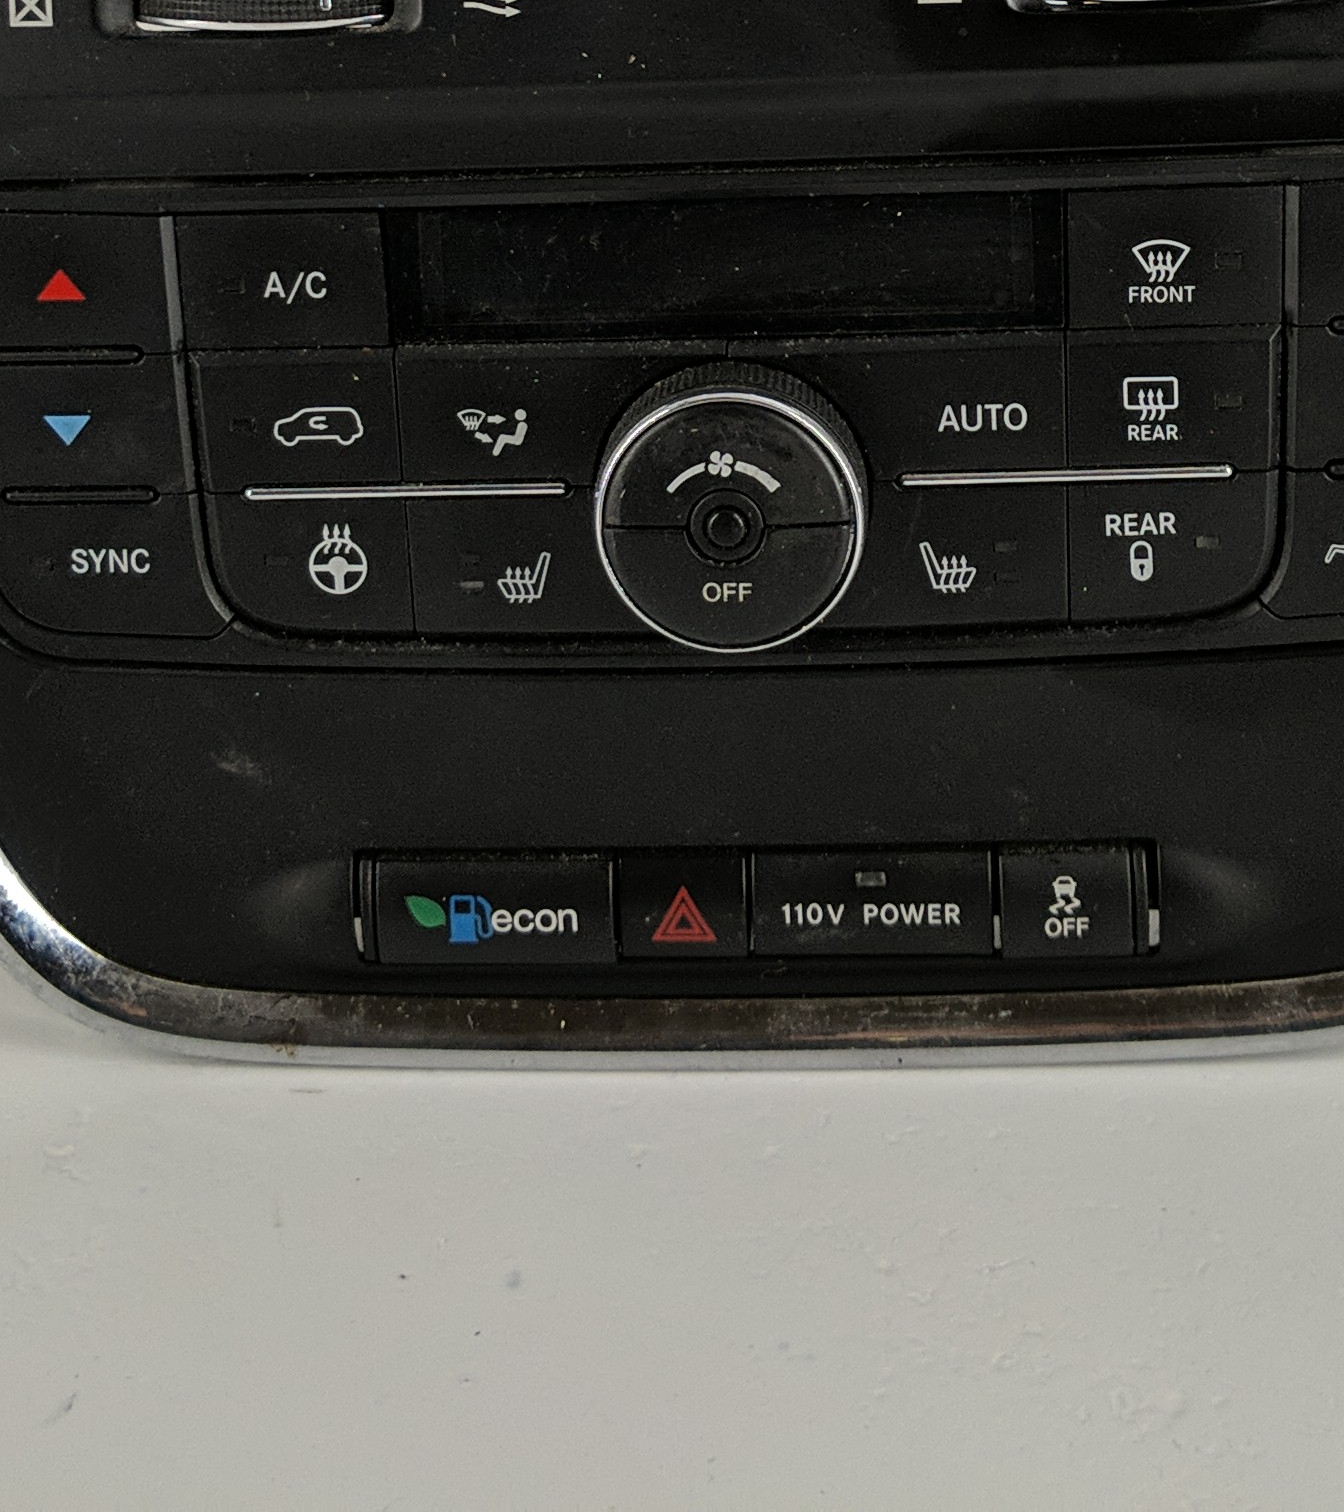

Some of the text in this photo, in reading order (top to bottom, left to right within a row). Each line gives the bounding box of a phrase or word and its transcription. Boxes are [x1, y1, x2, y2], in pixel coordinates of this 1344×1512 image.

[263, 271, 327, 305] A/C
[1128, 285, 1196, 304] FRONT
[937, 402, 1028, 432] AUTO
[1127, 423, 1178, 442] REAR
[1104, 511, 1177, 537] REAR
[70, 548, 151, 575] SYNC
[702, 582, 753, 603] OFF
[491, 908, 579, 933] econ
[863, 902, 961, 925] POWER
[1044, 916, 1089, 939] OFF
